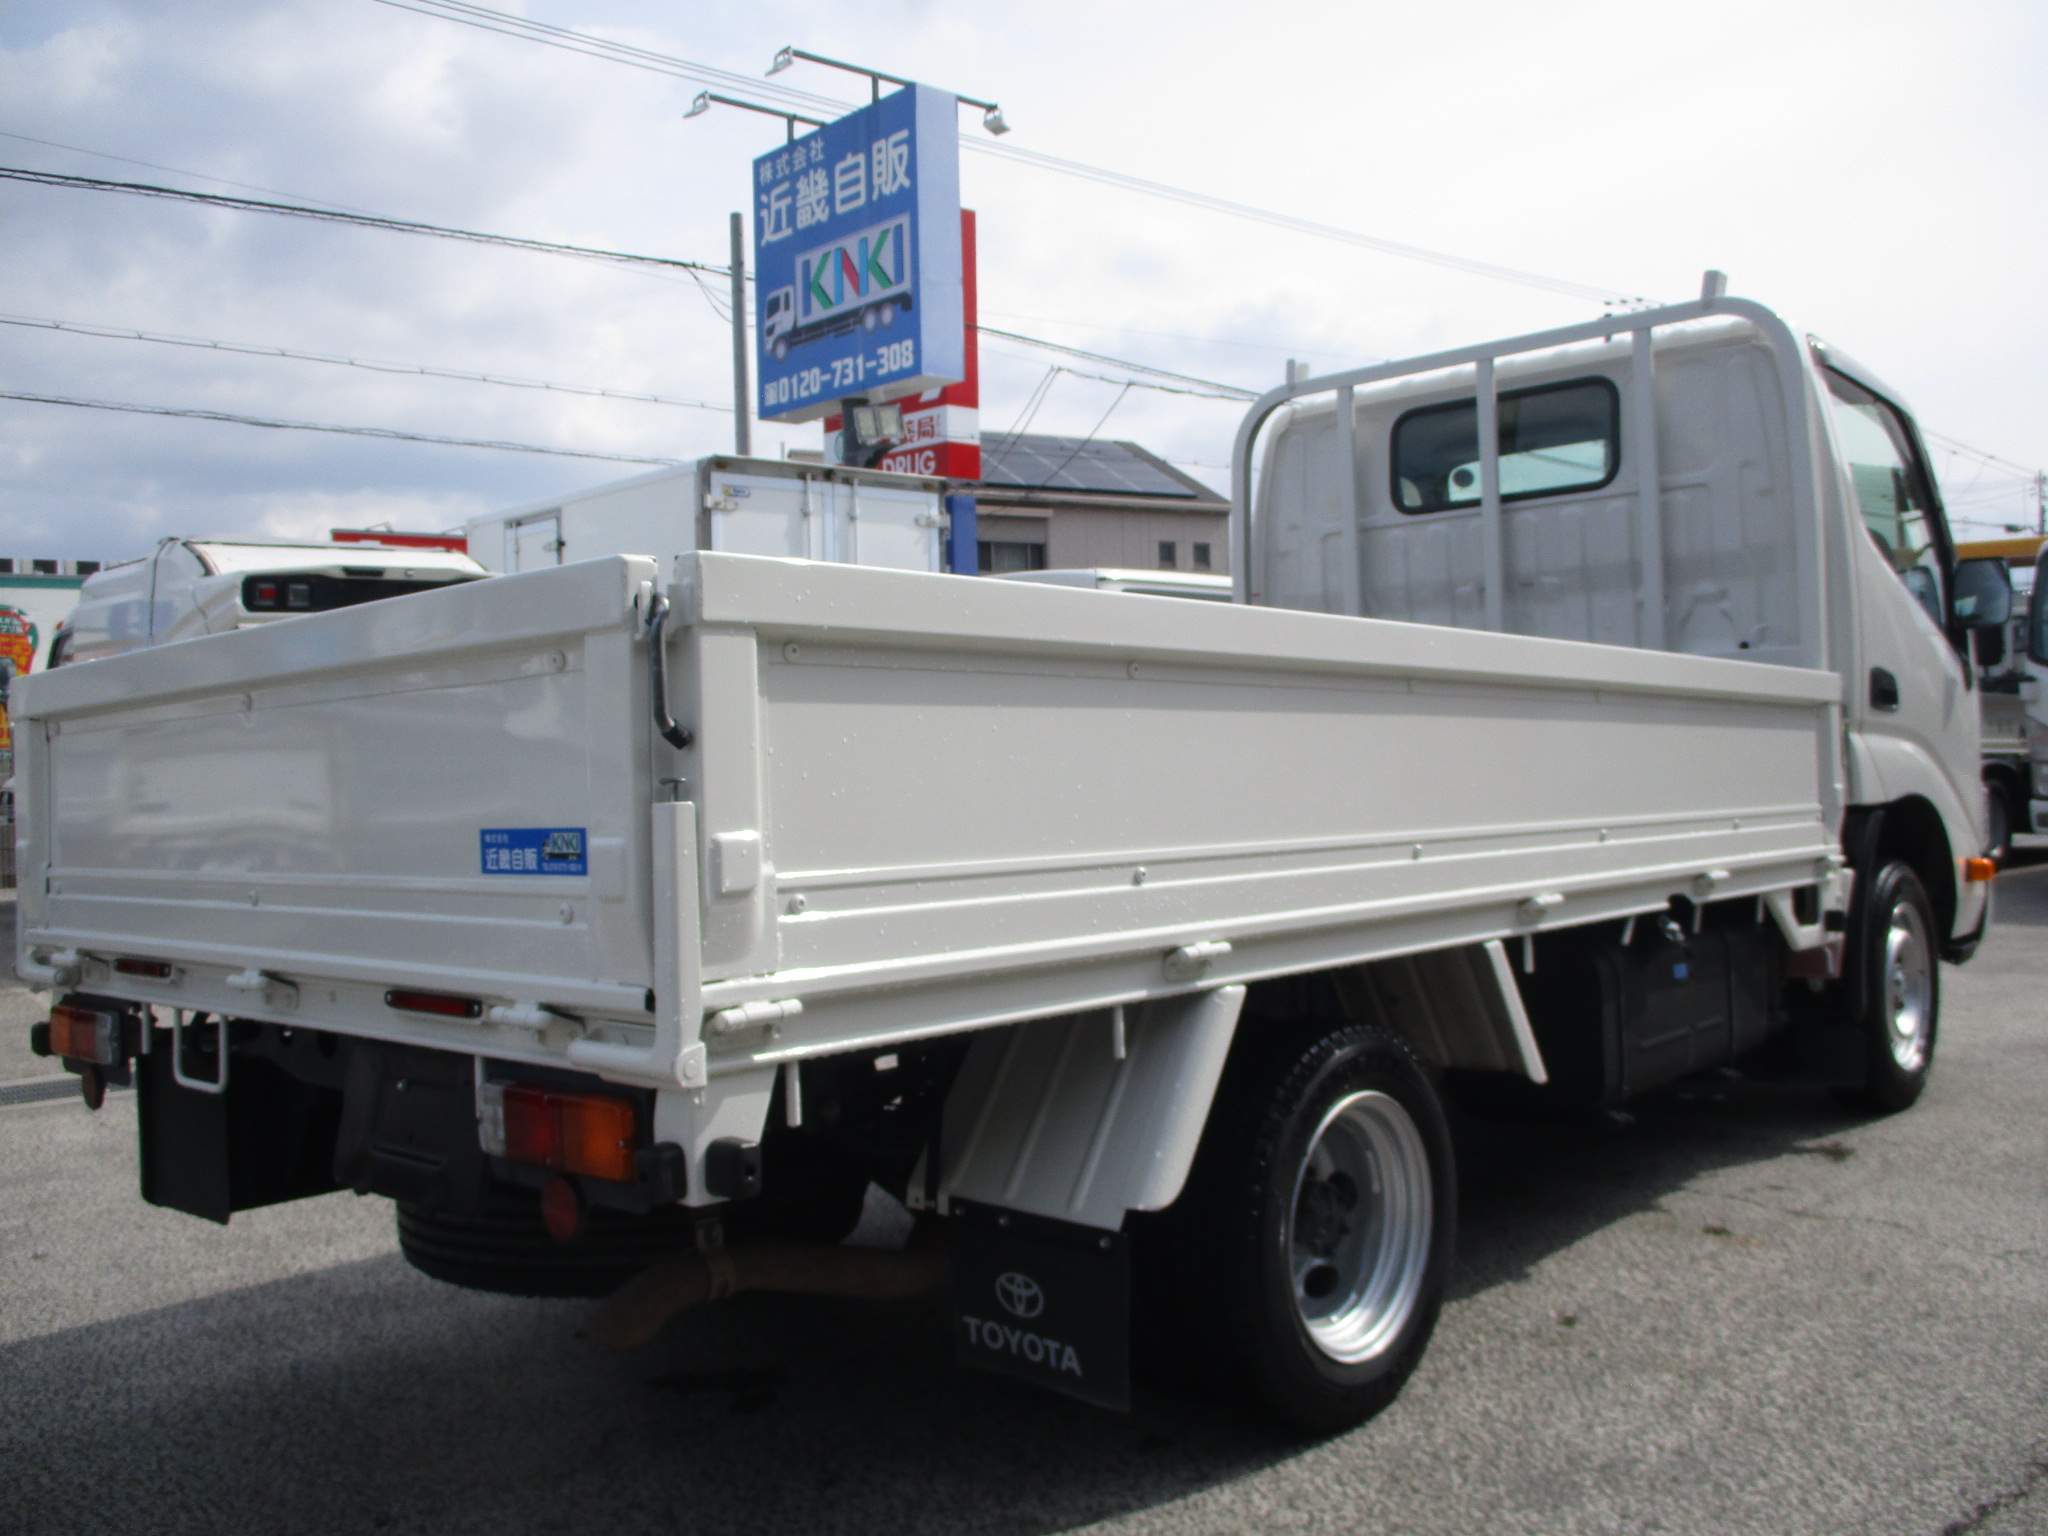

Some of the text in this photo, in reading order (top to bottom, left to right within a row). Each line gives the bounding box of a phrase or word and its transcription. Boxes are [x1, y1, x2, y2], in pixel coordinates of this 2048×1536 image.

[759, 136, 825, 187] 株式会社
[760, 128, 911, 247] 近畿自販
[777, 338, 914, 404] 0120-731-308
[882, 449, 936, 476] DRUG
[962, 1315, 1083, 1377] TOYOTA
